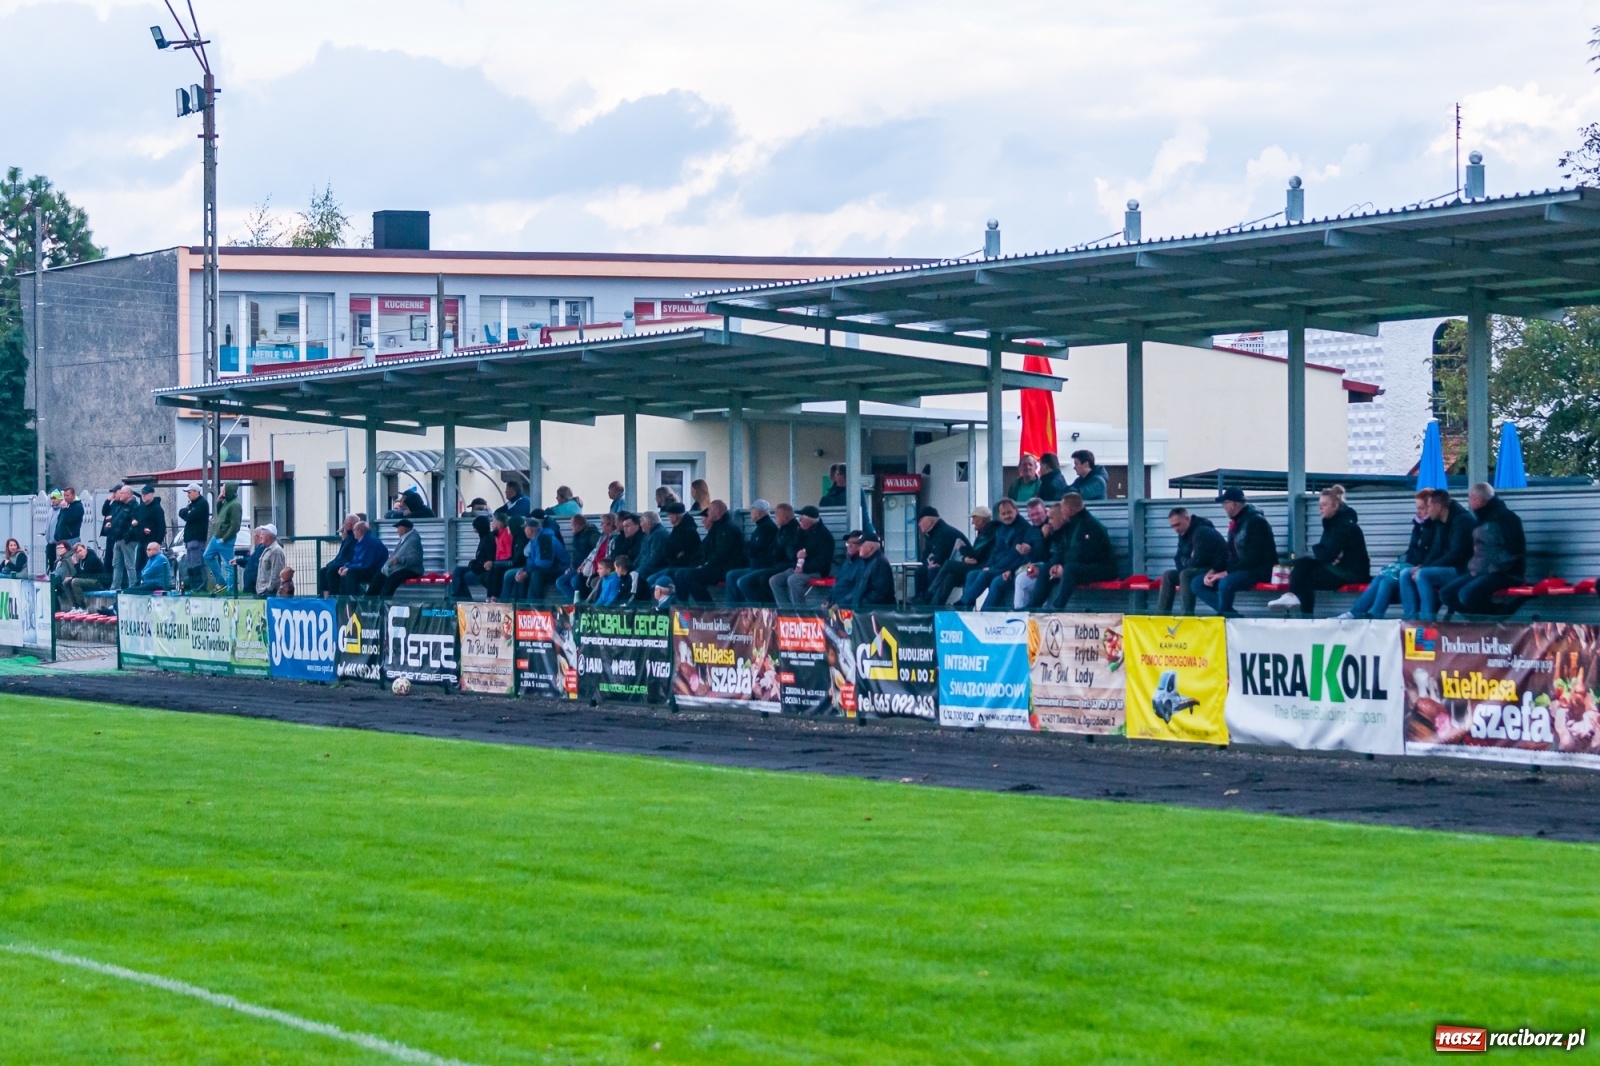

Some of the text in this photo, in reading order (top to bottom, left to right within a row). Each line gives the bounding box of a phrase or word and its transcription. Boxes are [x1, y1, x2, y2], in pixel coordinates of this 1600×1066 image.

[384, 300, 424, 308] KUCHENNE
[252, 350, 280, 359] MEBLE
[886, 478, 918, 487] WARKA
[156, 622, 190, 640] AKADEMIA
[192, 616, 220, 632] MŁODEGO
[1074, 624, 1099, 640] Kebab
[940, 630, 963, 644] SZYBKI
[899, 648, 934, 662] BUDUJEMY
[944, 654, 989, 672] INTERNET
[1074, 645, 1099, 665] Frytki
[1141, 654, 1163, 667] POMOC
[1164, 655, 1197, 668] DROGOWA
[710, 657, 752, 694] szefa
[900, 668, 934, 682] OD A DO Z
[1040, 662, 1052, 682] The
[1075, 668, 1094, 687] Lody
[1240, 644, 1388, 702] KERAKOLL
[1274, 704, 1289, 719] The
[1292, 706, 1346, 724] GreenBding
[1470, 691, 1554, 743] szefa
